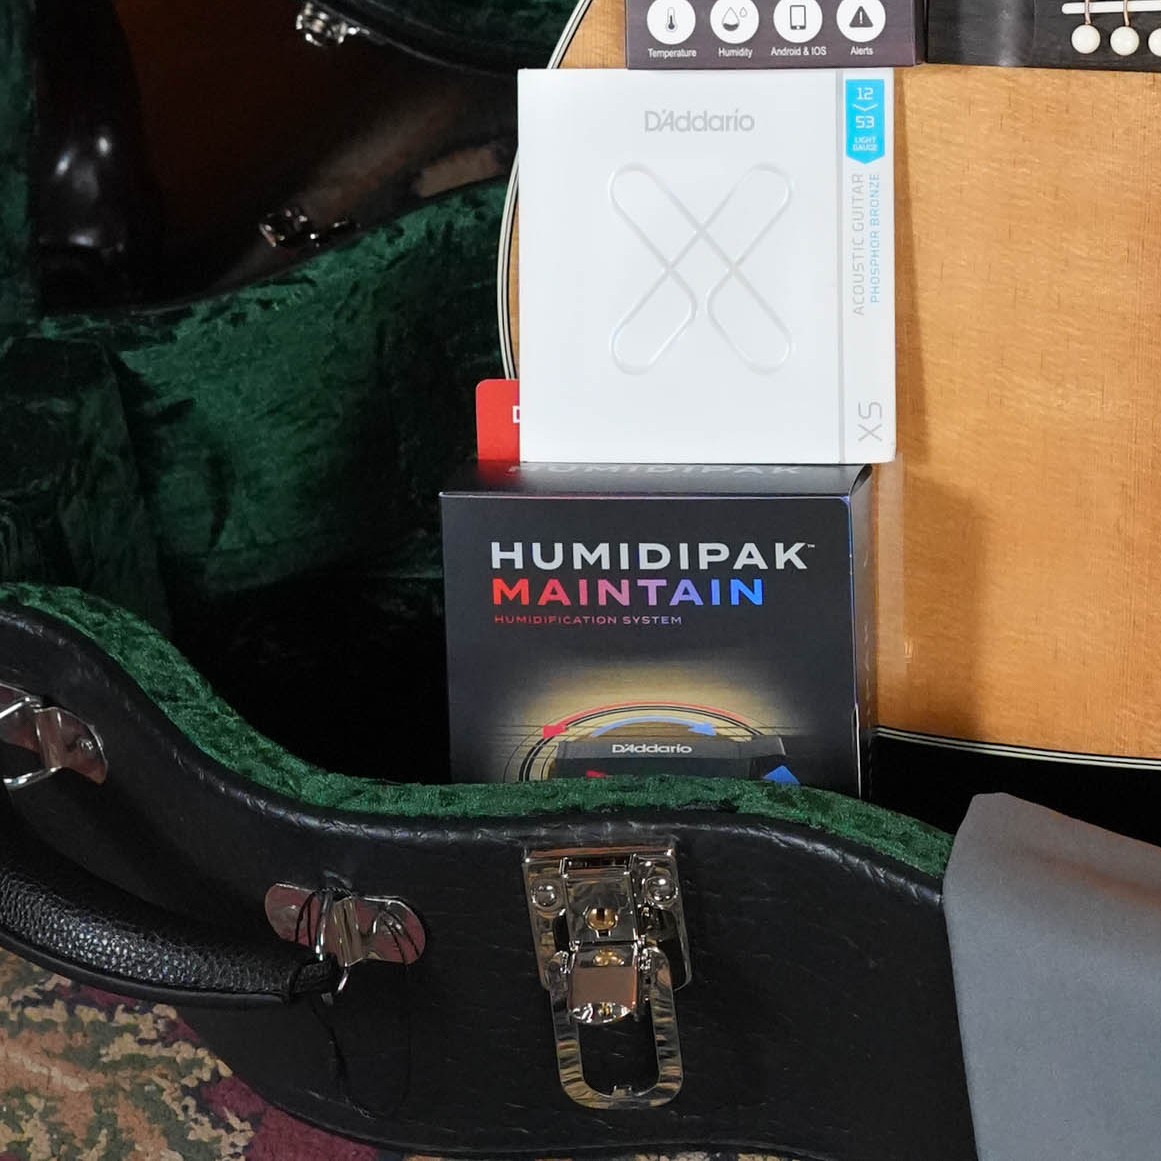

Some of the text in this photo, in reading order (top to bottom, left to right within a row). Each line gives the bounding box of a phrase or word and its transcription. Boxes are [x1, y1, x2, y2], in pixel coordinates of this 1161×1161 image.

[648, 48, 697, 59] Temperature
[718, 47, 753, 59] Humidity
[770, 46, 801, 56] Android
[803, 46, 810, 56] &
[850, 46, 873, 56] Alerts
[856, 86, 874, 100] 12
[855, 115, 874, 129] 53
[853, 173, 865, 316] ACOUSTIC GUITAR
[870, 173, 881, 303] PHOSPHOR BRONZE
[858, 400, 883, 442] XS
[492, 578, 764, 606] MAINTAIN
[494, 615, 682, 625] HUMIDIFICATION SYSTEM
